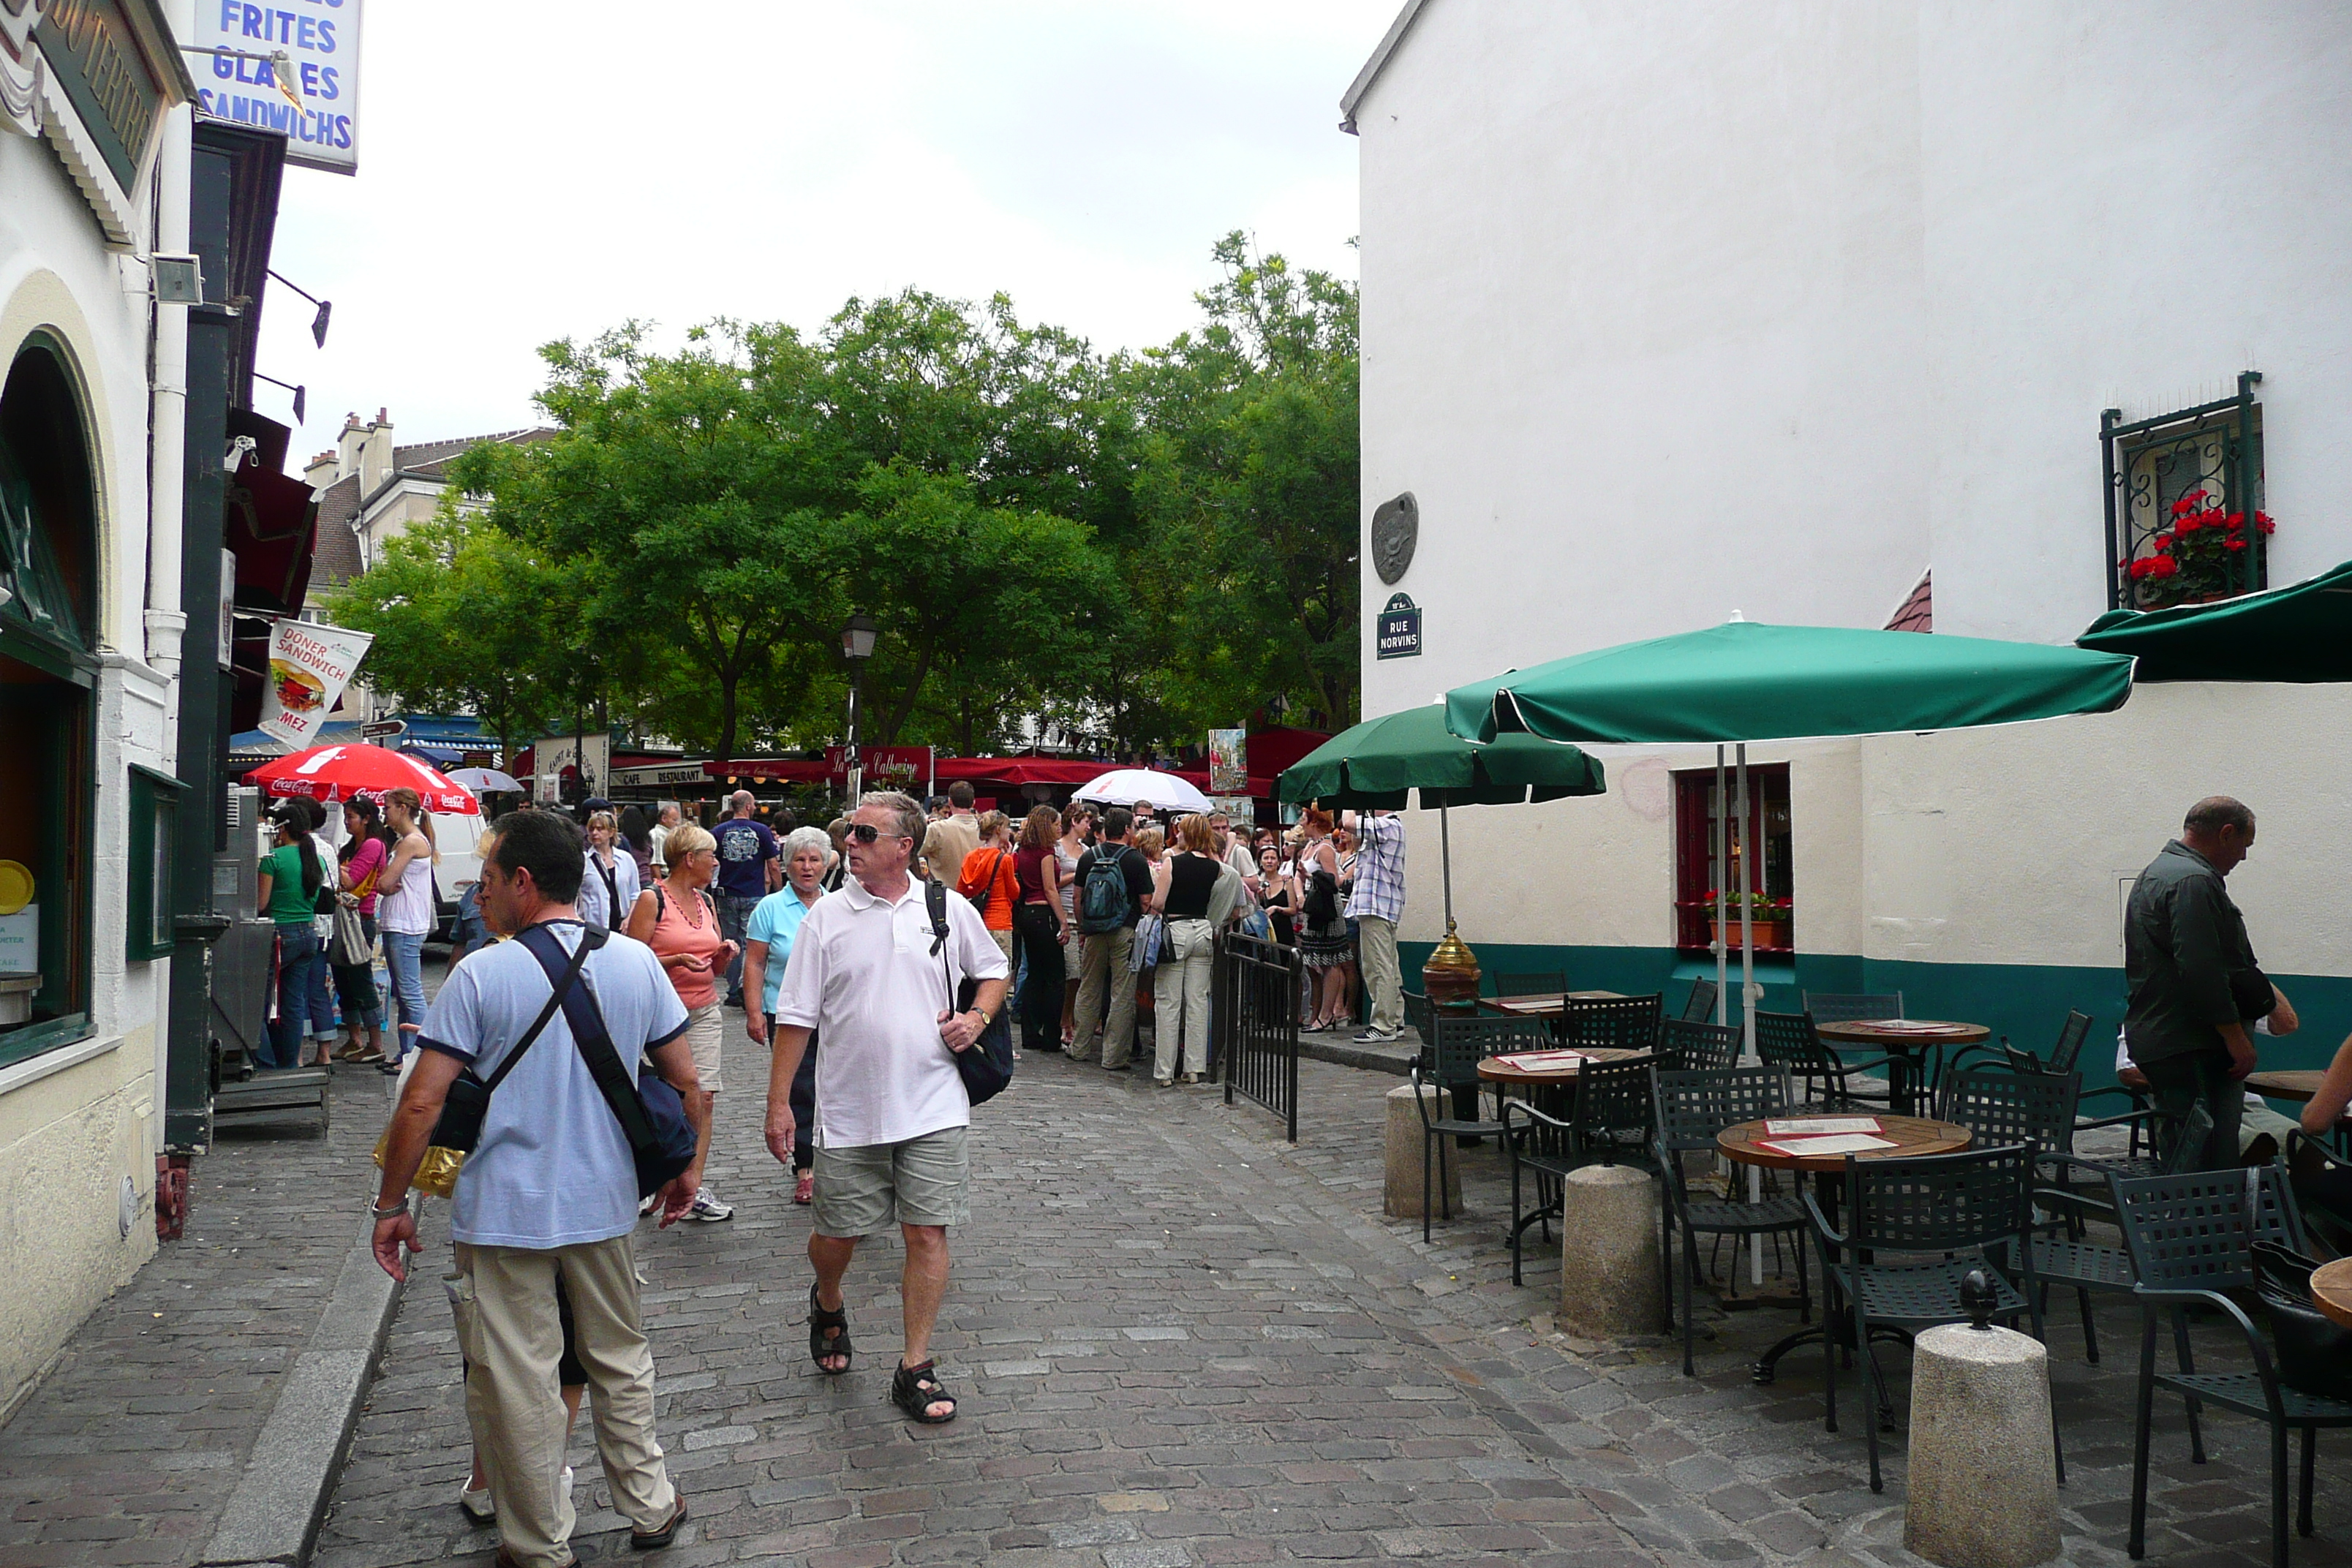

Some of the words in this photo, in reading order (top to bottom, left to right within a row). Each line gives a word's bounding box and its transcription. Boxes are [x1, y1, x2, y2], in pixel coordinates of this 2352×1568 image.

[220, 0, 336, 53] FRITES
[213, 45, 339, 100] GLAES
[197, 88, 352, 149] SANDWICHS
[1390, 620, 1408, 633] RUE
[1381, 634, 1417, 649] NORVINS
[276, 638, 346, 681] SANDWICH
[276, 712, 309, 733] MEZ
[832, 751, 845, 774] La
[657, 770, 700, 783] RESTAURANT
